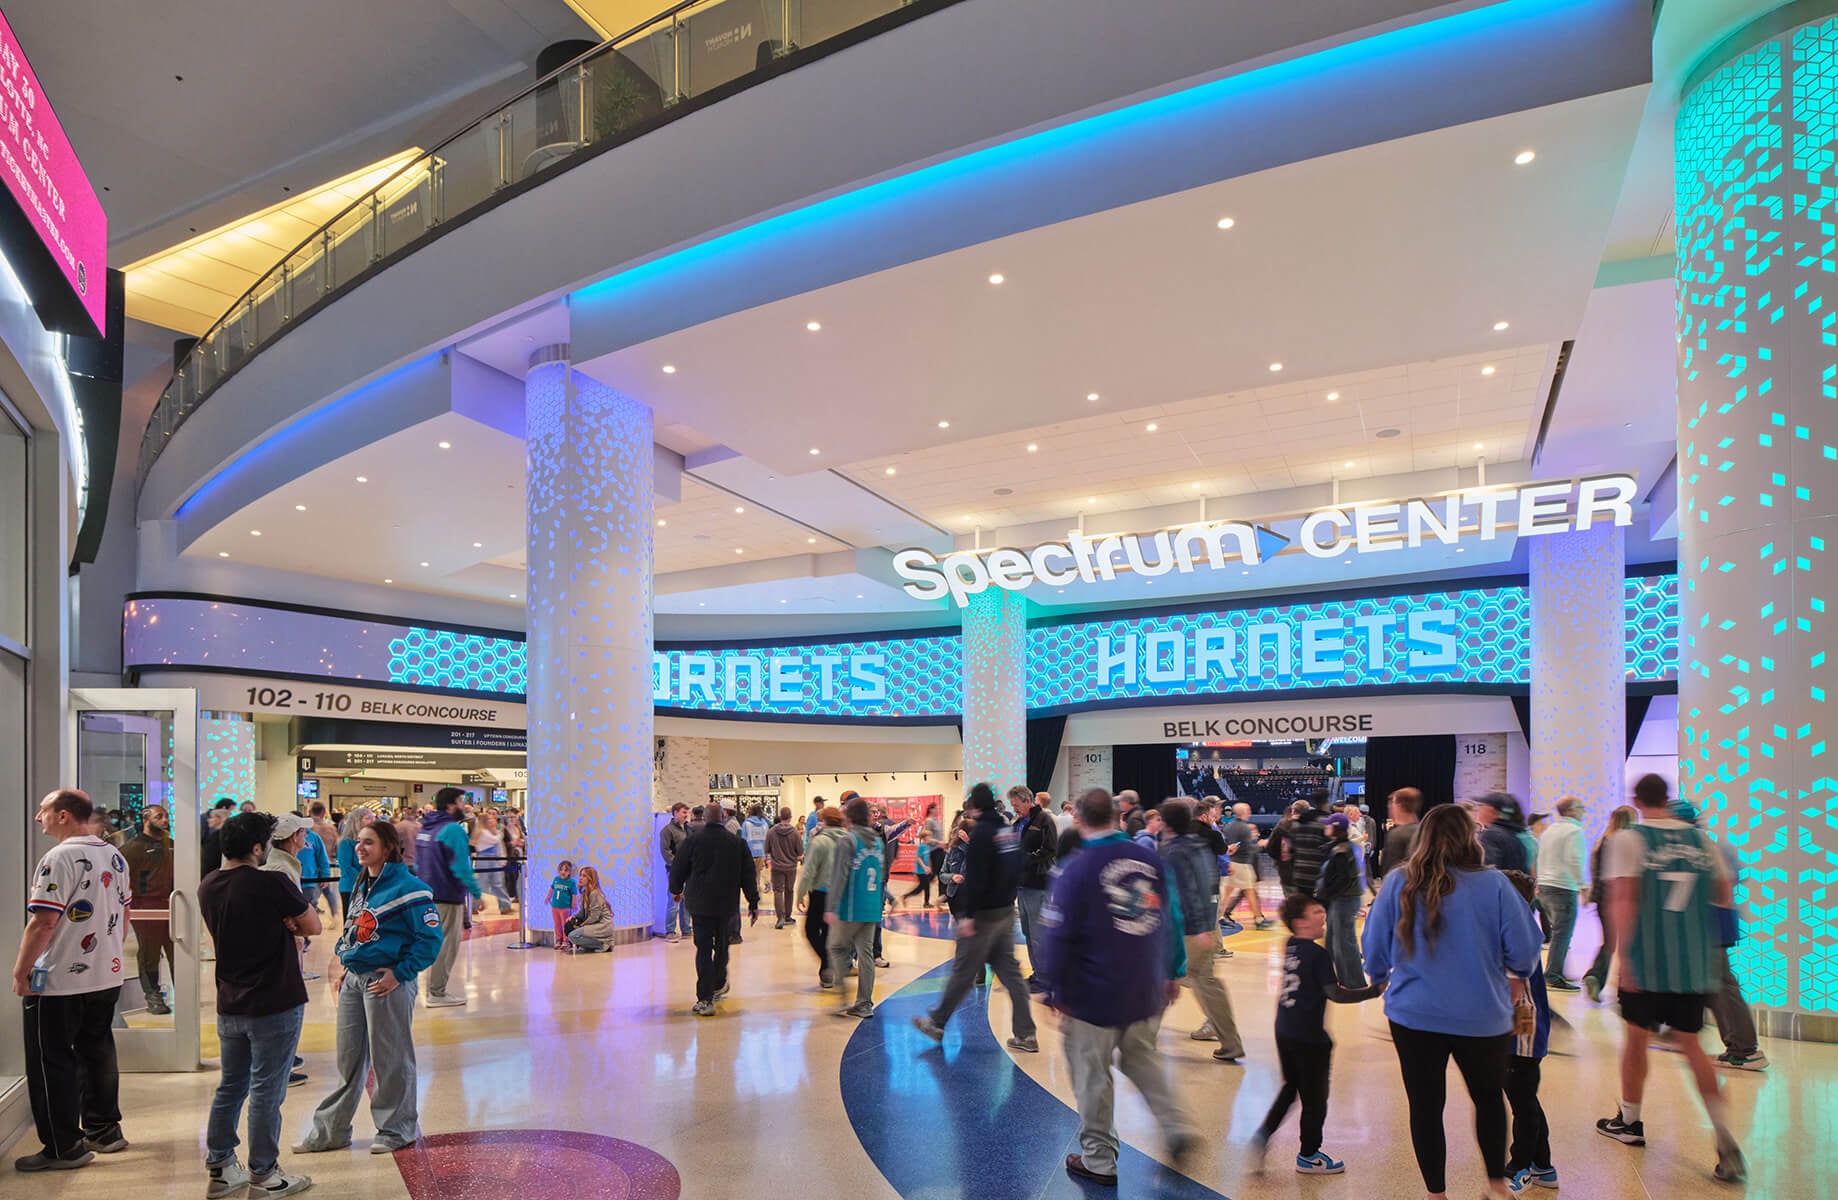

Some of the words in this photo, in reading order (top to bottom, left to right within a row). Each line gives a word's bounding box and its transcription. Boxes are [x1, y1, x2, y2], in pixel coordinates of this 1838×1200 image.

[22, 137, 66, 224] CENTER
[893, 520, 1260, 608] Spectrum
[1300, 473, 1639, 558] CENTER
[1096, 609, 1458, 687] HORNETS
[247, 687, 292, 708] 102
[315, 692, 352, 712] 110
[360, 701, 404, 716] BELK
[406, 704, 497, 722] CONCOURSE
[1163, 720, 1221, 738] BELK
[1225, 714, 1373, 736] CONCOURSE
[1085, 753, 1102, 763] 101
[1464, 743, 1486, 754] 118
[866, 867, 877, 891] 2
[1656, 872, 1698, 913] 7
